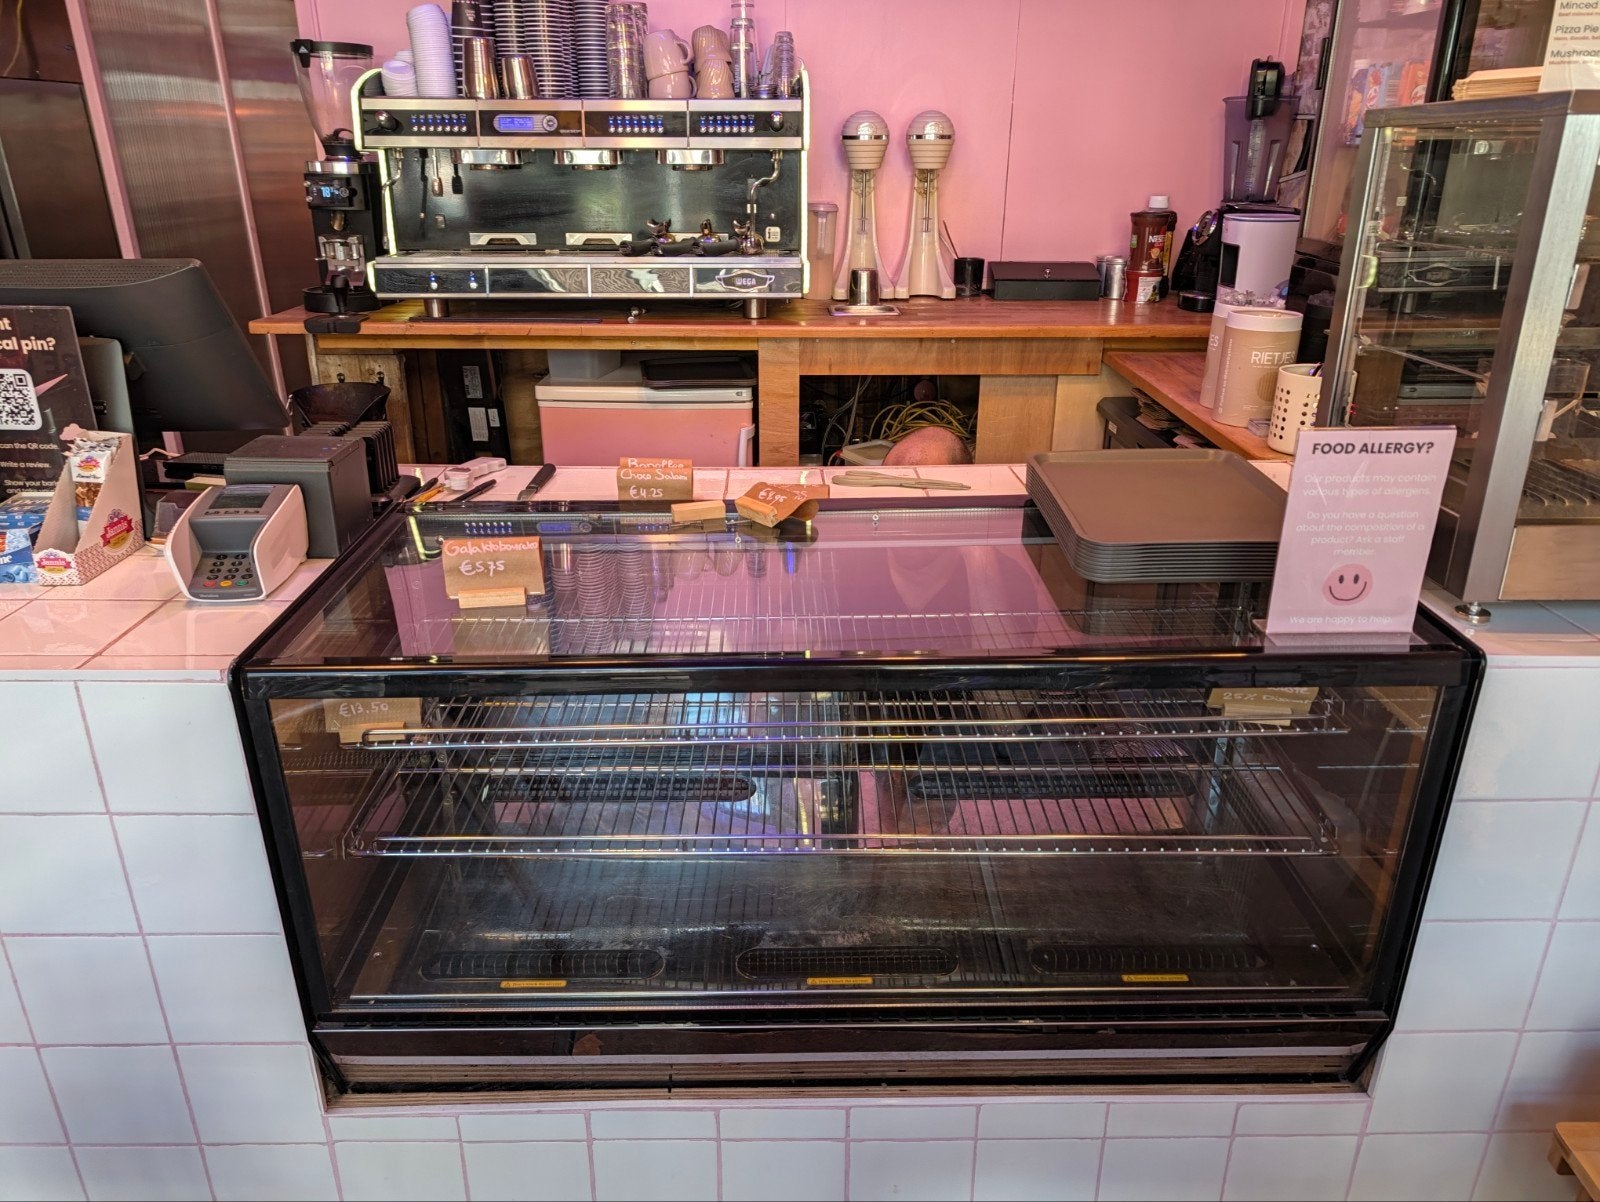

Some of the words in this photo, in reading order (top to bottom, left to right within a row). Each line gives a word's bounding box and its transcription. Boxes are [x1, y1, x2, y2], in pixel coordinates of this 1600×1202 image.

[1560, 1, 1599, 9] Minced
[1555, 25, 1581, 34] Pizza
[1584, 24, 1600, 34] Pie
[1550, 49, 1600, 58] Mushroo
[735, 277, 757, 285] WEGA
[20, 336, 56, 354] pin?
[1250, 350, 1297, 365] RIETJES
[27, 442, 39, 450] QR
[1312, 443, 1355, 454] FOOD
[1359, 442, 1435, 454] ALLERGY?
[620, 468, 652, 480] Choco
[1304, 473, 1323, 483] Our
[1325, 473, 1371, 484] products
[1373, 474, 1395, 484] may
[1398, 473, 1437, 482] contain
[1303, 487, 1339, 496] various
[1342, 487, 1369, 499] types
[1372, 486, 1383, 496] of
[1384, 486, 1432, 498] allergens.
[1306, 511, 1320, 520] Do
[1322, 512, 1340, 521] you
[1343, 511, 1366, 519] have
[1377, 510, 1419, 521] question
[1296, 523, 1325, 532] about
[1327, 523, 1343, 531] the
[1345, 523, 1404, 533] composition
[1406, 523, 1416, 531] of
[1310, 535, 1354, 546] product?
[1356, 535, 1372, 544] Ask
[1383, 534, 1405, 544] staff
[458, 559, 506, 577] €5.75
[1289, 616, 1305, 624] We
[1306, 616, 1323, 624] are
[1325, 615, 1356, 625] happy
[1370, 615, 1393, 625] help.
[339, 702, 390, 717] €13.50
